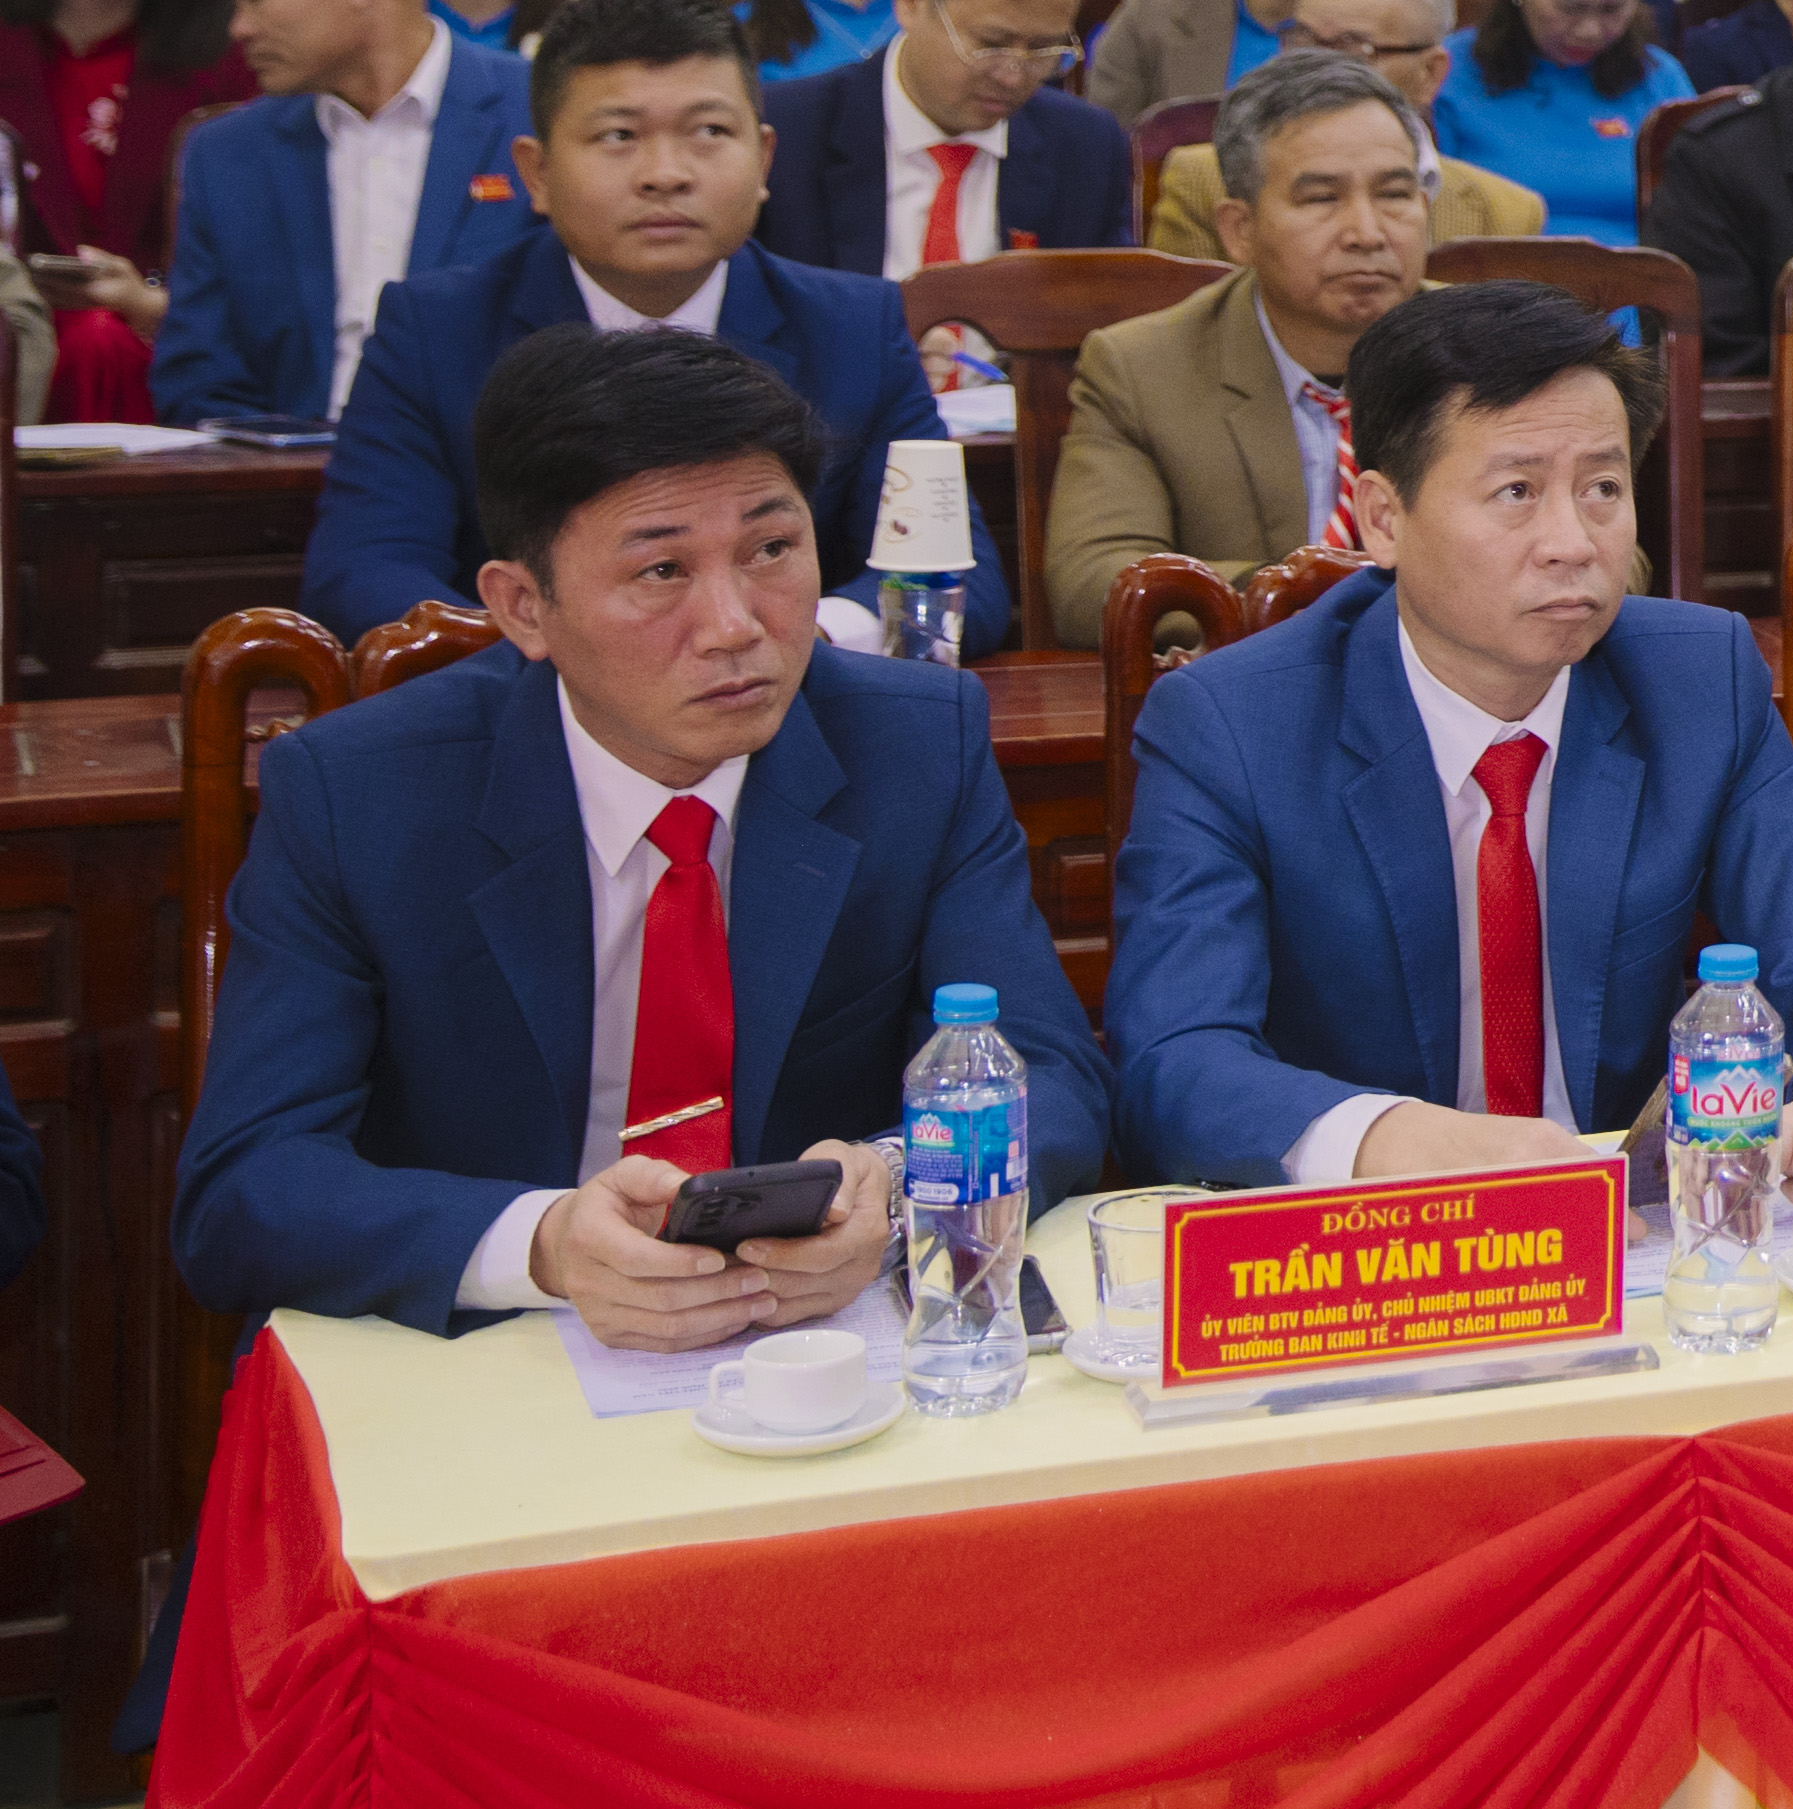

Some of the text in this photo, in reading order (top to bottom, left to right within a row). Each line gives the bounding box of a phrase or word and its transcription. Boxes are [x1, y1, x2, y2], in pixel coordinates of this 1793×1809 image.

[1691, 1081, 1776, 1116] laVie
[912, 1121, 951, 1140] laVie
[1321, 1193, 1475, 1234] ĐỒNG CHÍ
[1229, 1228, 1563, 1298] TRẦN VĂN TÙNG
